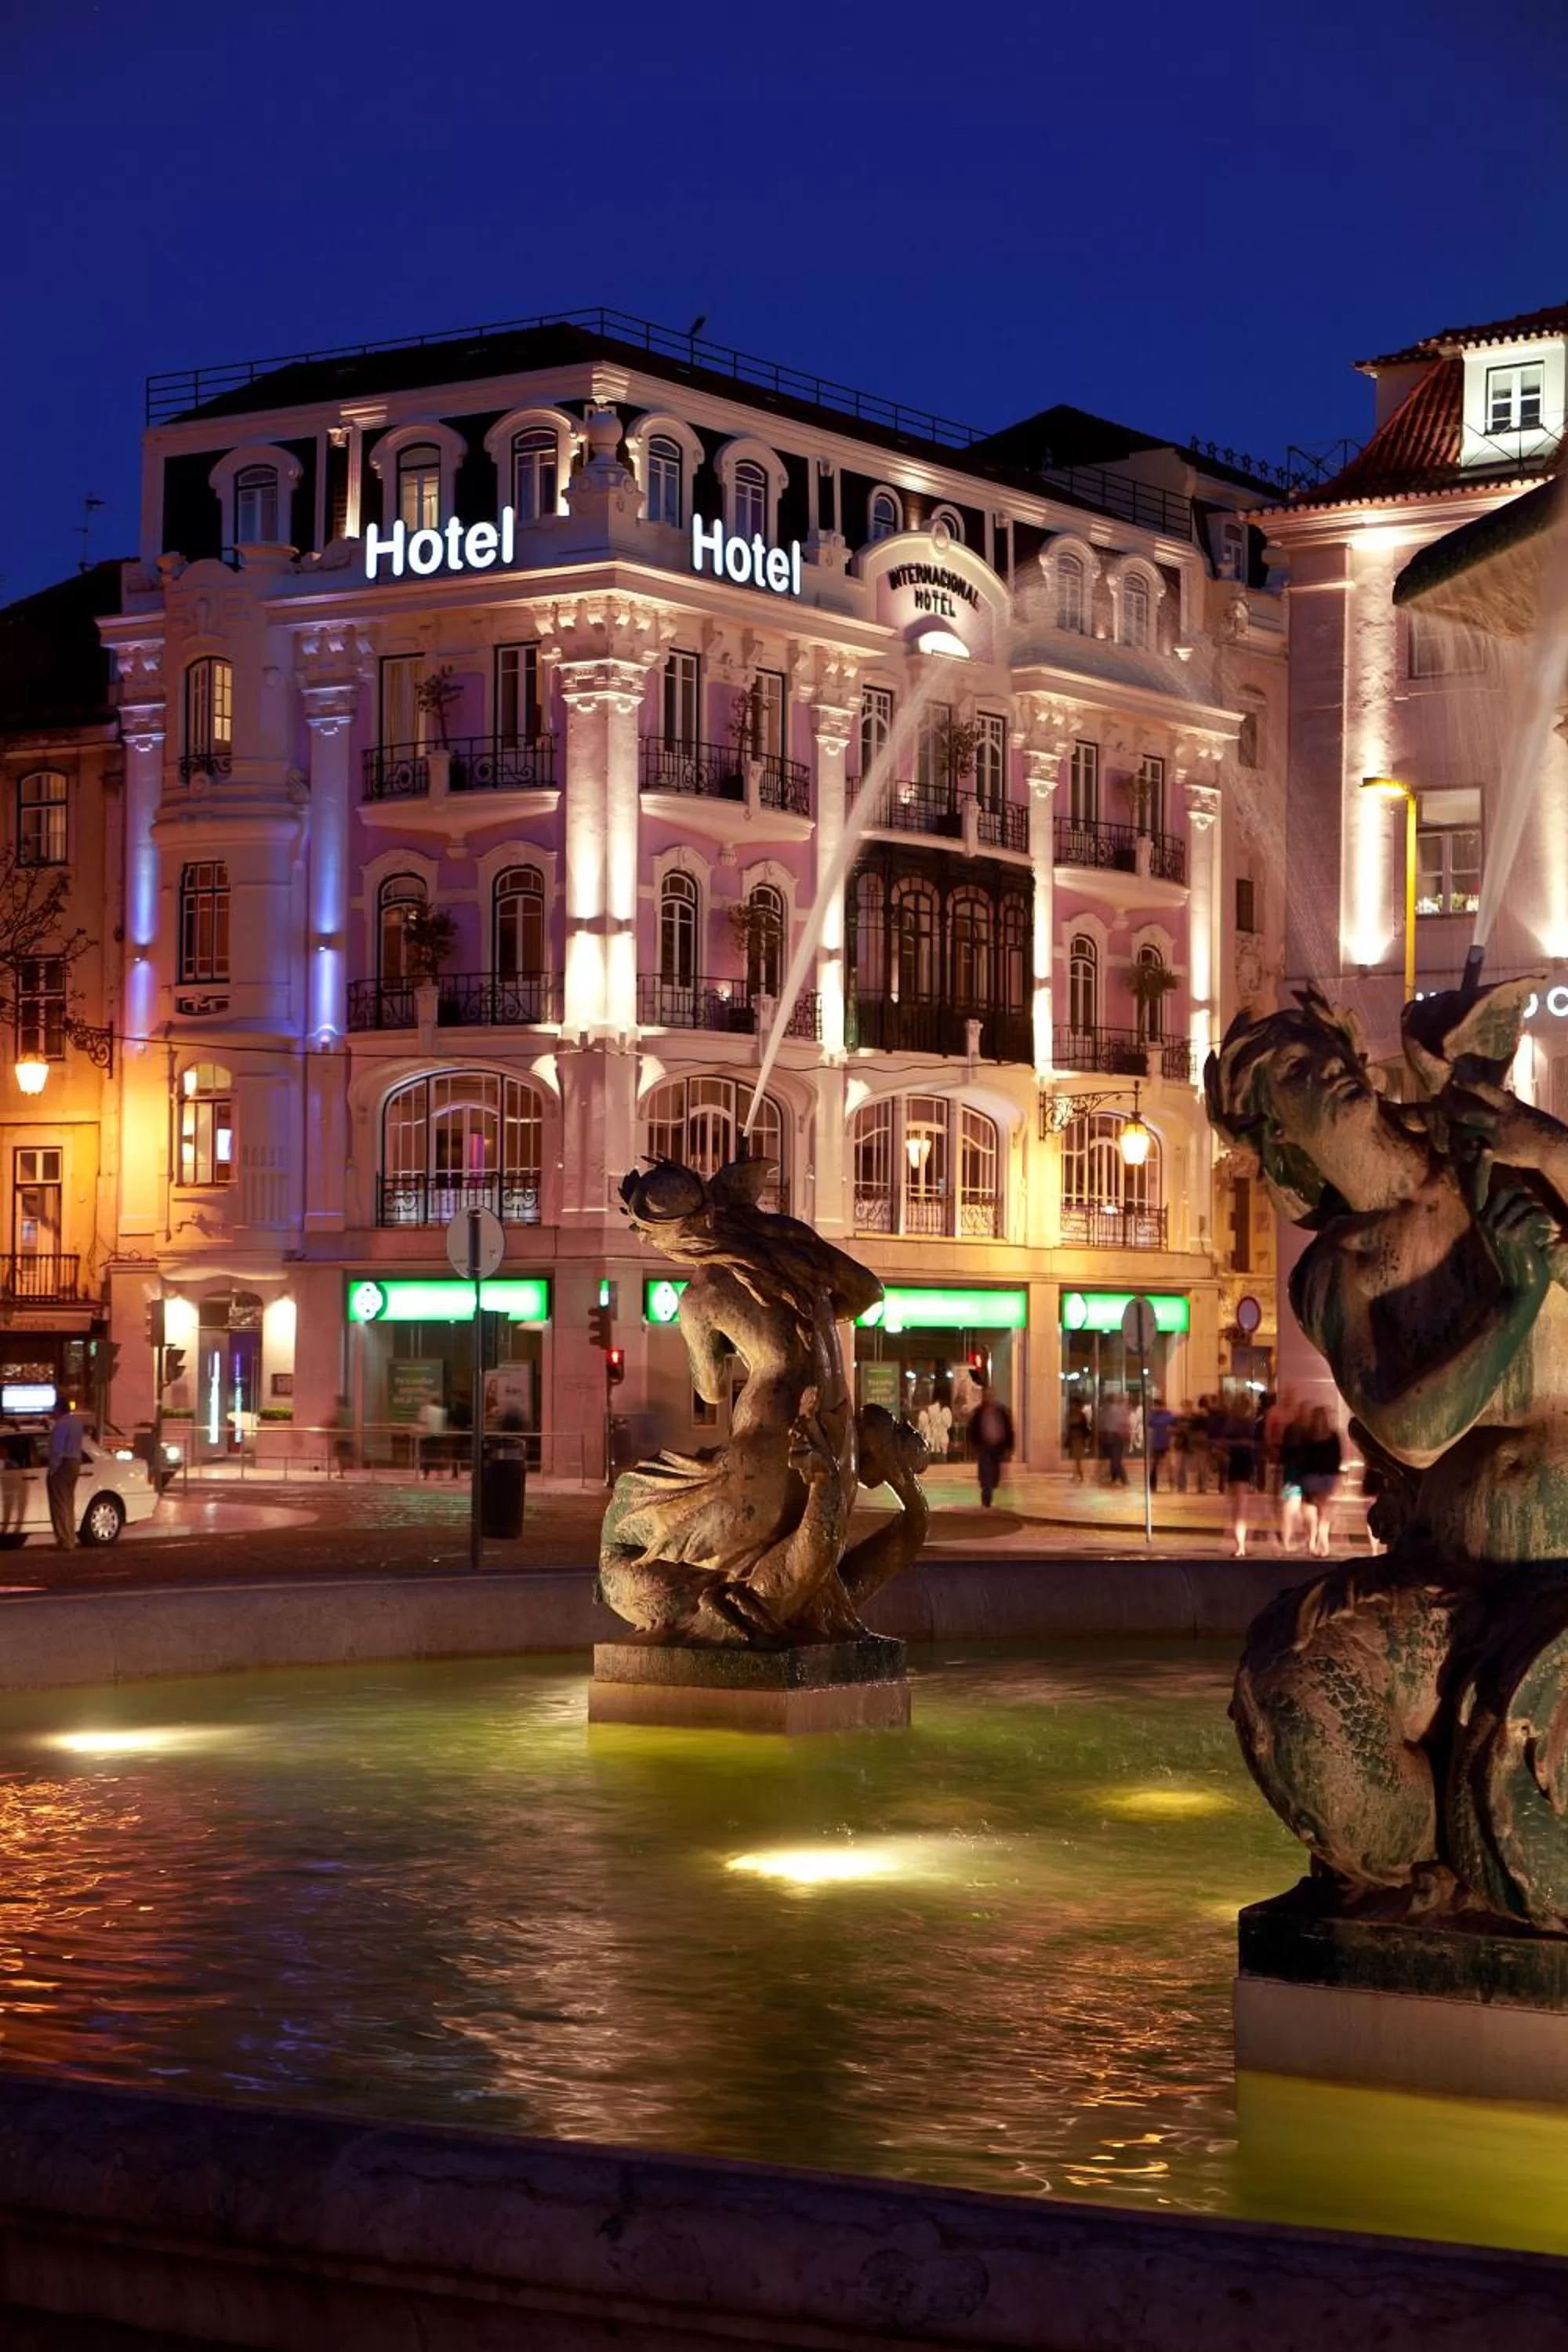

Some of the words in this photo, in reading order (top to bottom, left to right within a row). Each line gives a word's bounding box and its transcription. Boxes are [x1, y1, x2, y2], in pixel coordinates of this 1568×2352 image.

[365, 505, 514, 579] Hotel
[692, 513, 801, 596] Hotel
[887, 562, 979, 612] INTERNACIONAL
[914, 588, 956, 618] HOTEL
